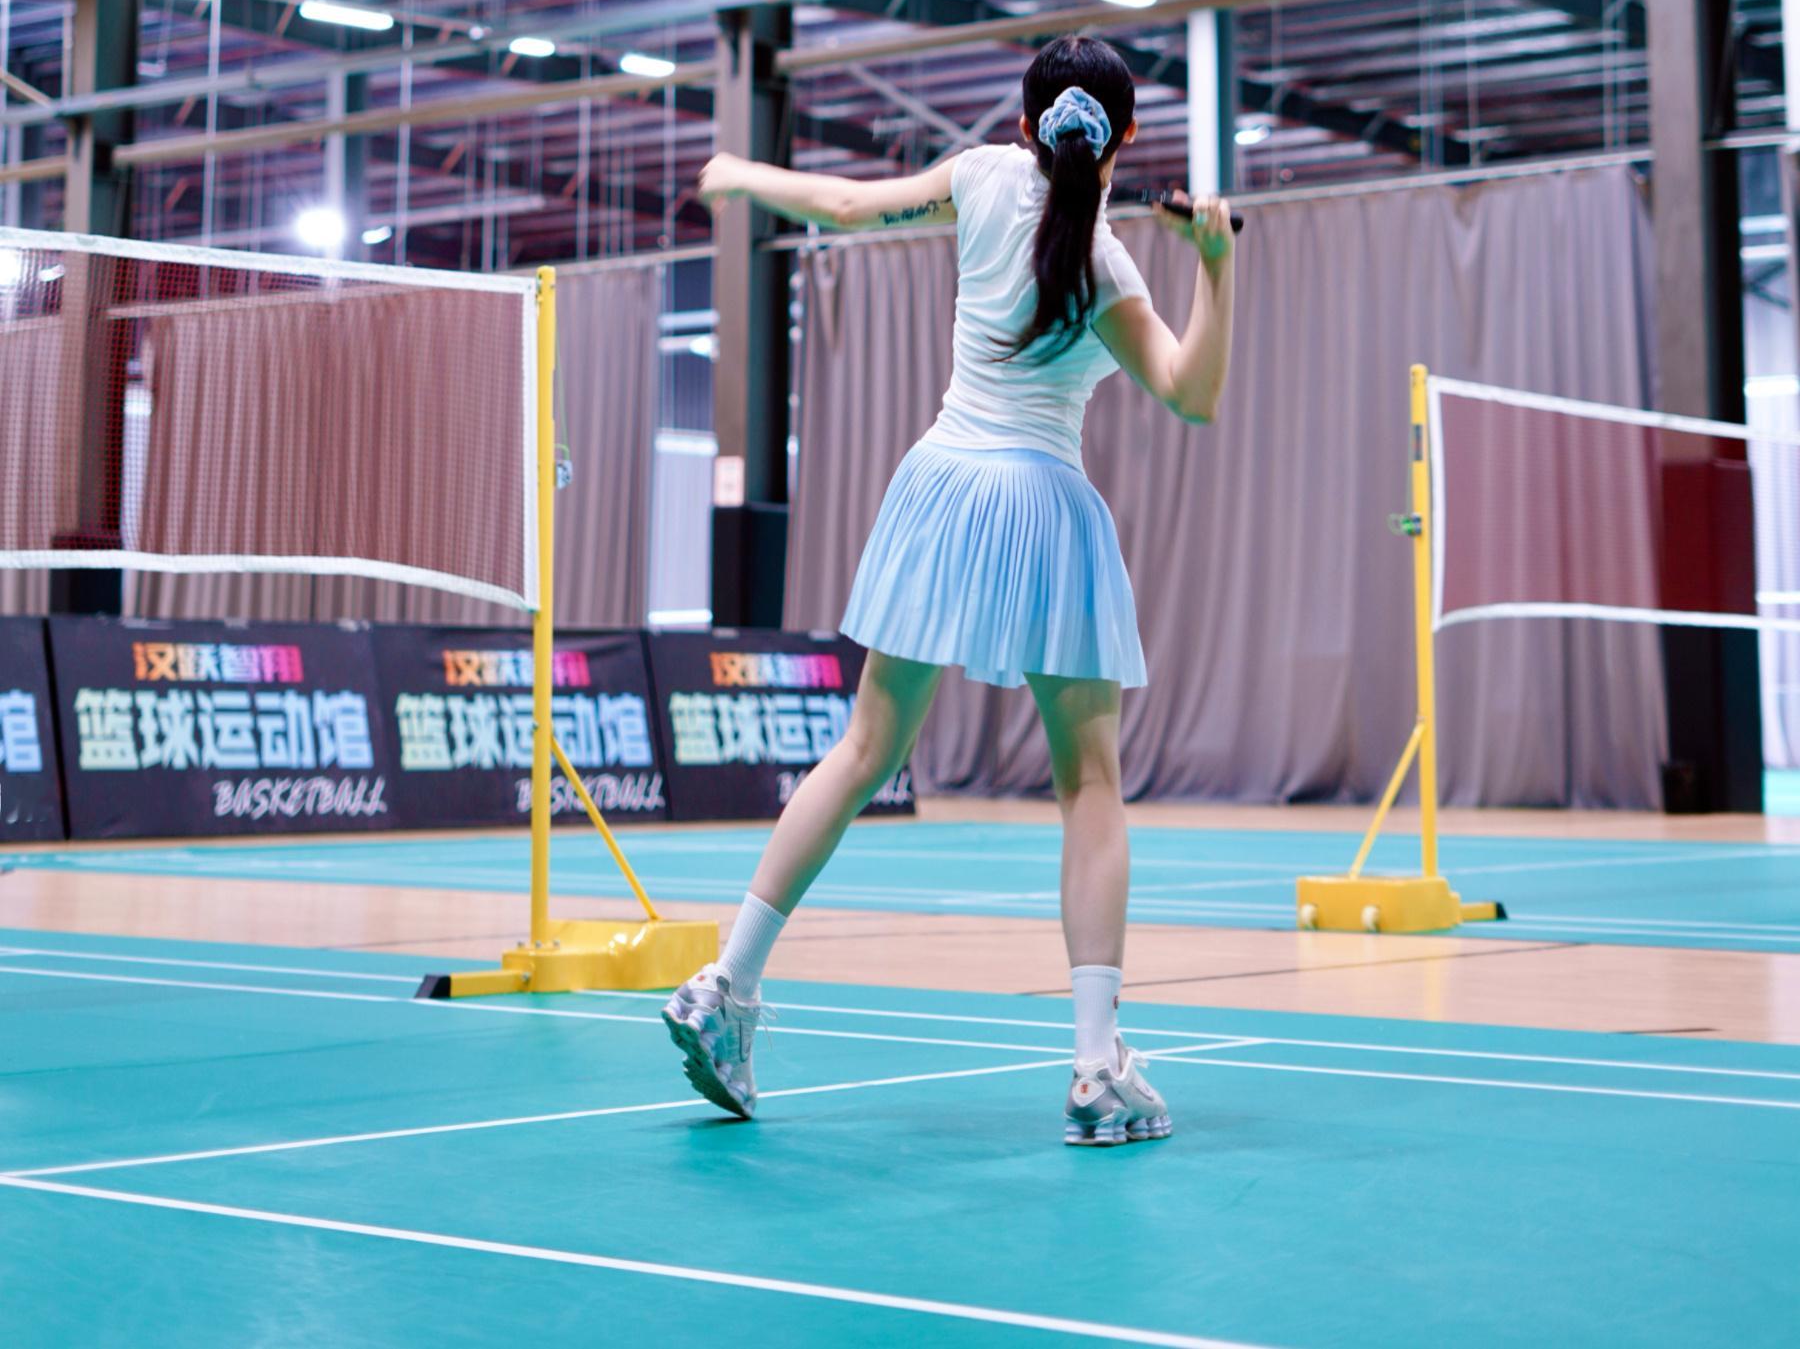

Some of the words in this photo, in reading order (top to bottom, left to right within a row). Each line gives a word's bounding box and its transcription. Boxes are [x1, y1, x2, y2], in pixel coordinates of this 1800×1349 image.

[74, 687, 374, 771] 篮球运动馆
[669, 691, 857, 766] 篮球运动
[212, 775, 387, 820] BASKETBALL
